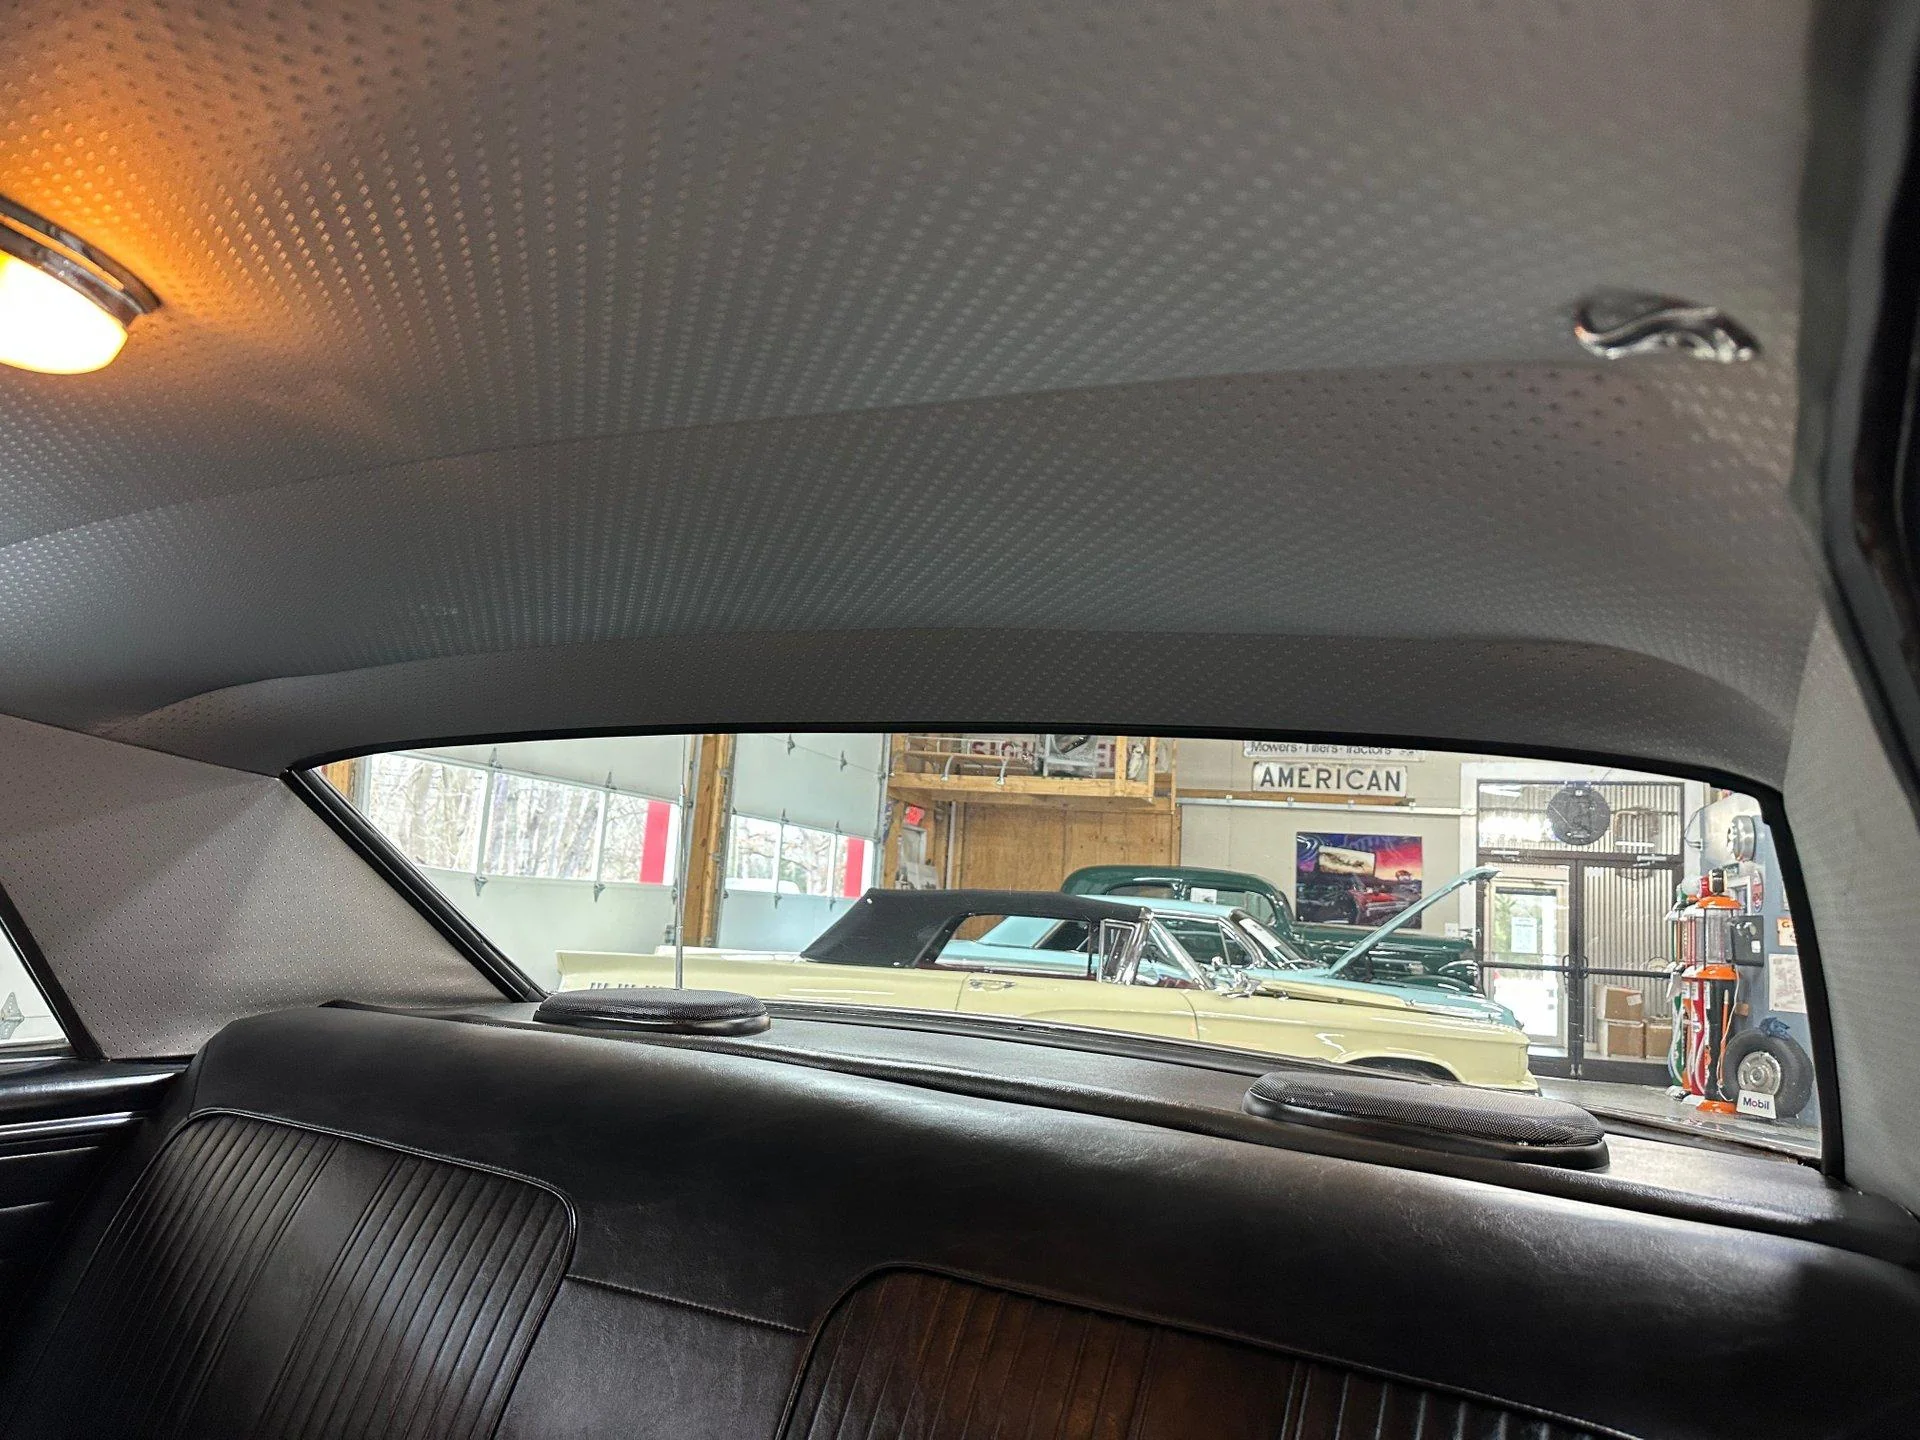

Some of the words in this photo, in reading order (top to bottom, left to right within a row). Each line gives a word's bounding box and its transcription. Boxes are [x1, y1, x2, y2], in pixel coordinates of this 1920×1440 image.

[1250, 741, 1298, 753] Mowers
[1259, 766, 1401, 792] AMERICAN
[1743, 1096, 1770, 1111] Mobil
